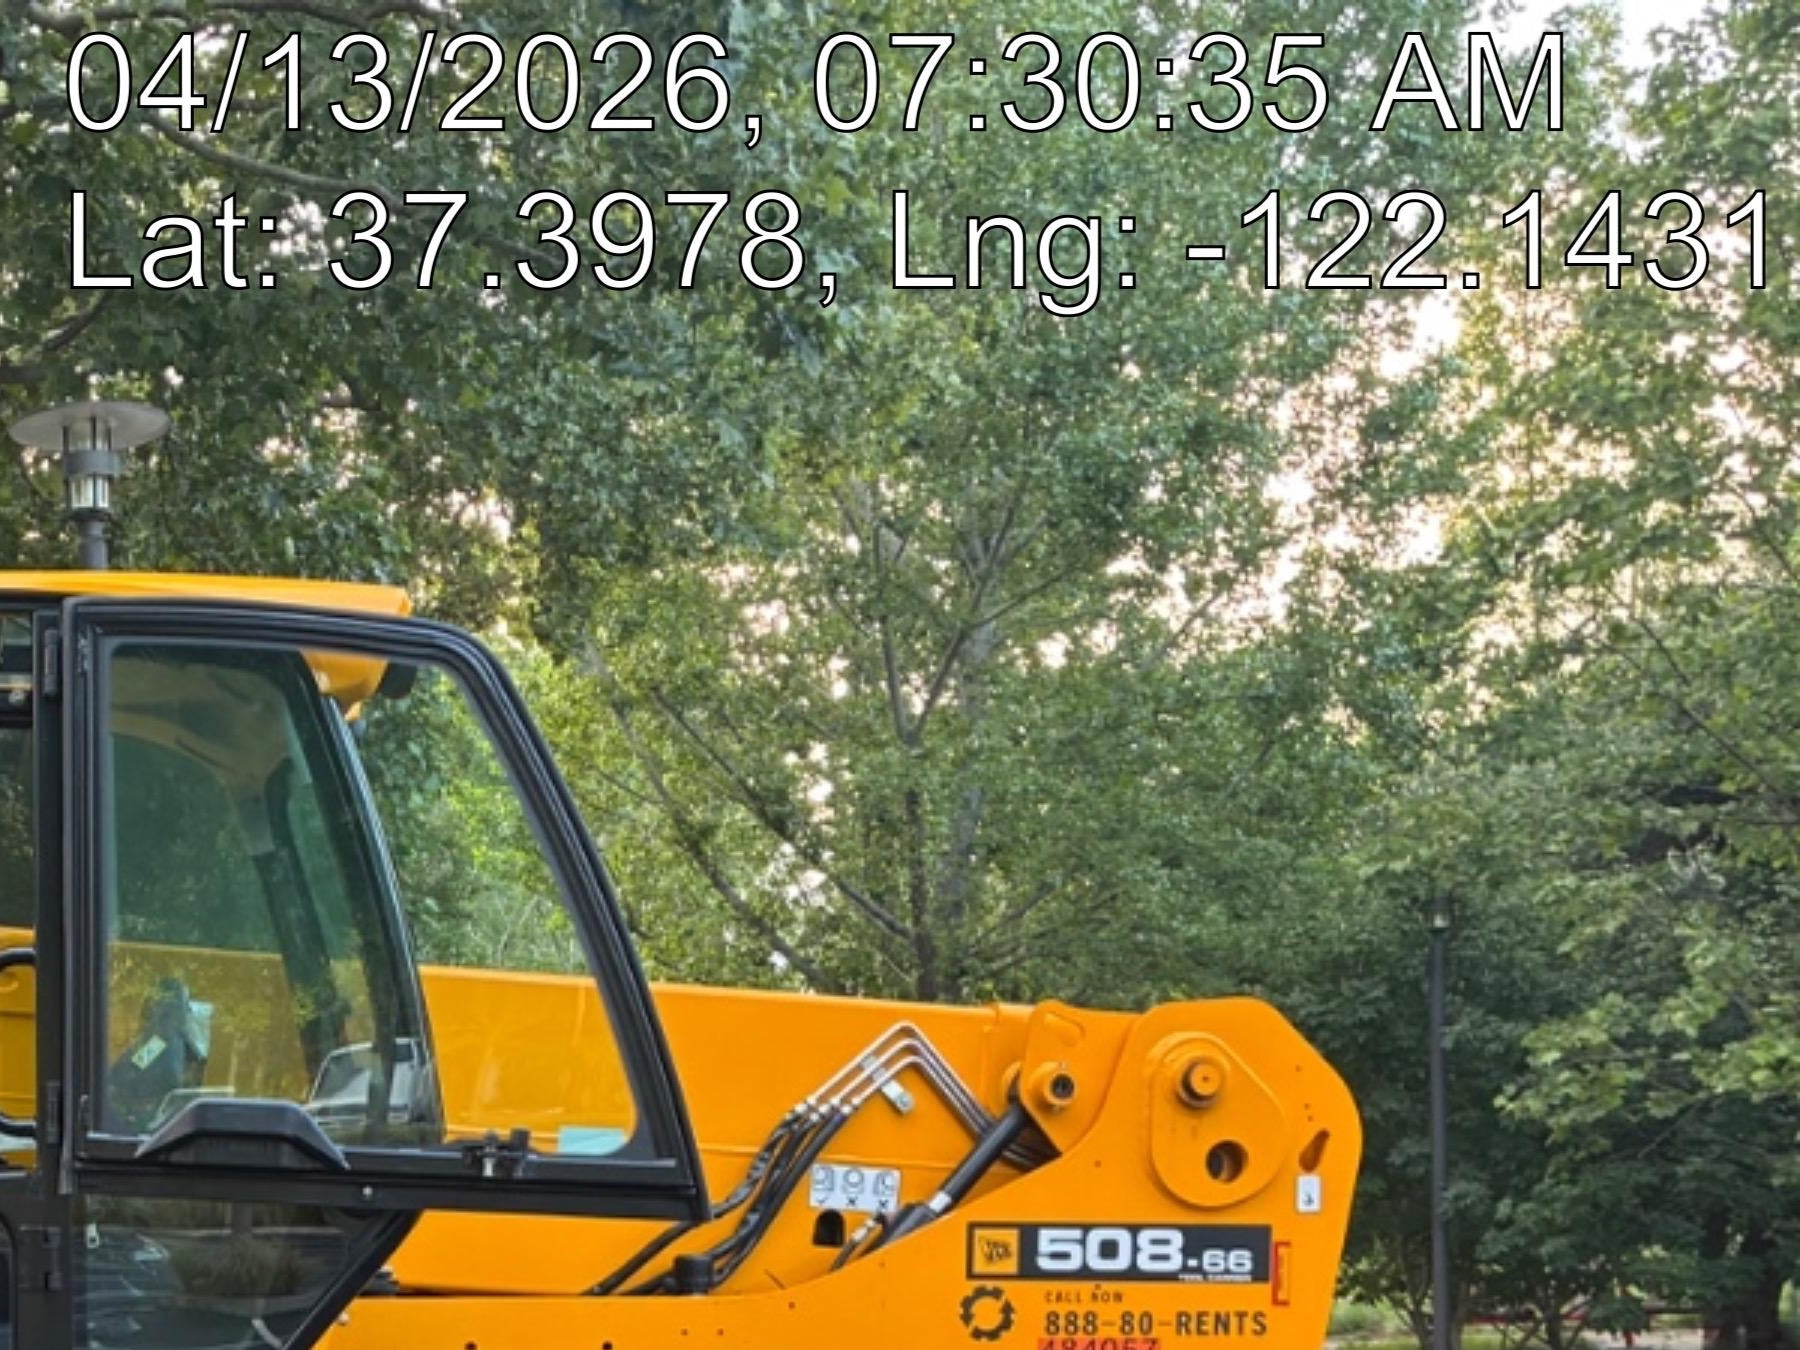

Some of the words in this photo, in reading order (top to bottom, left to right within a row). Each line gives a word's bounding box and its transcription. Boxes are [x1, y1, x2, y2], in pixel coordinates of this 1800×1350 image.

[1044, 1290, 1082, 1304] CALL
[1090, 1290, 1124, 1303] NOW
[1044, 1310, 1268, 1337] 888-80-RENTS
